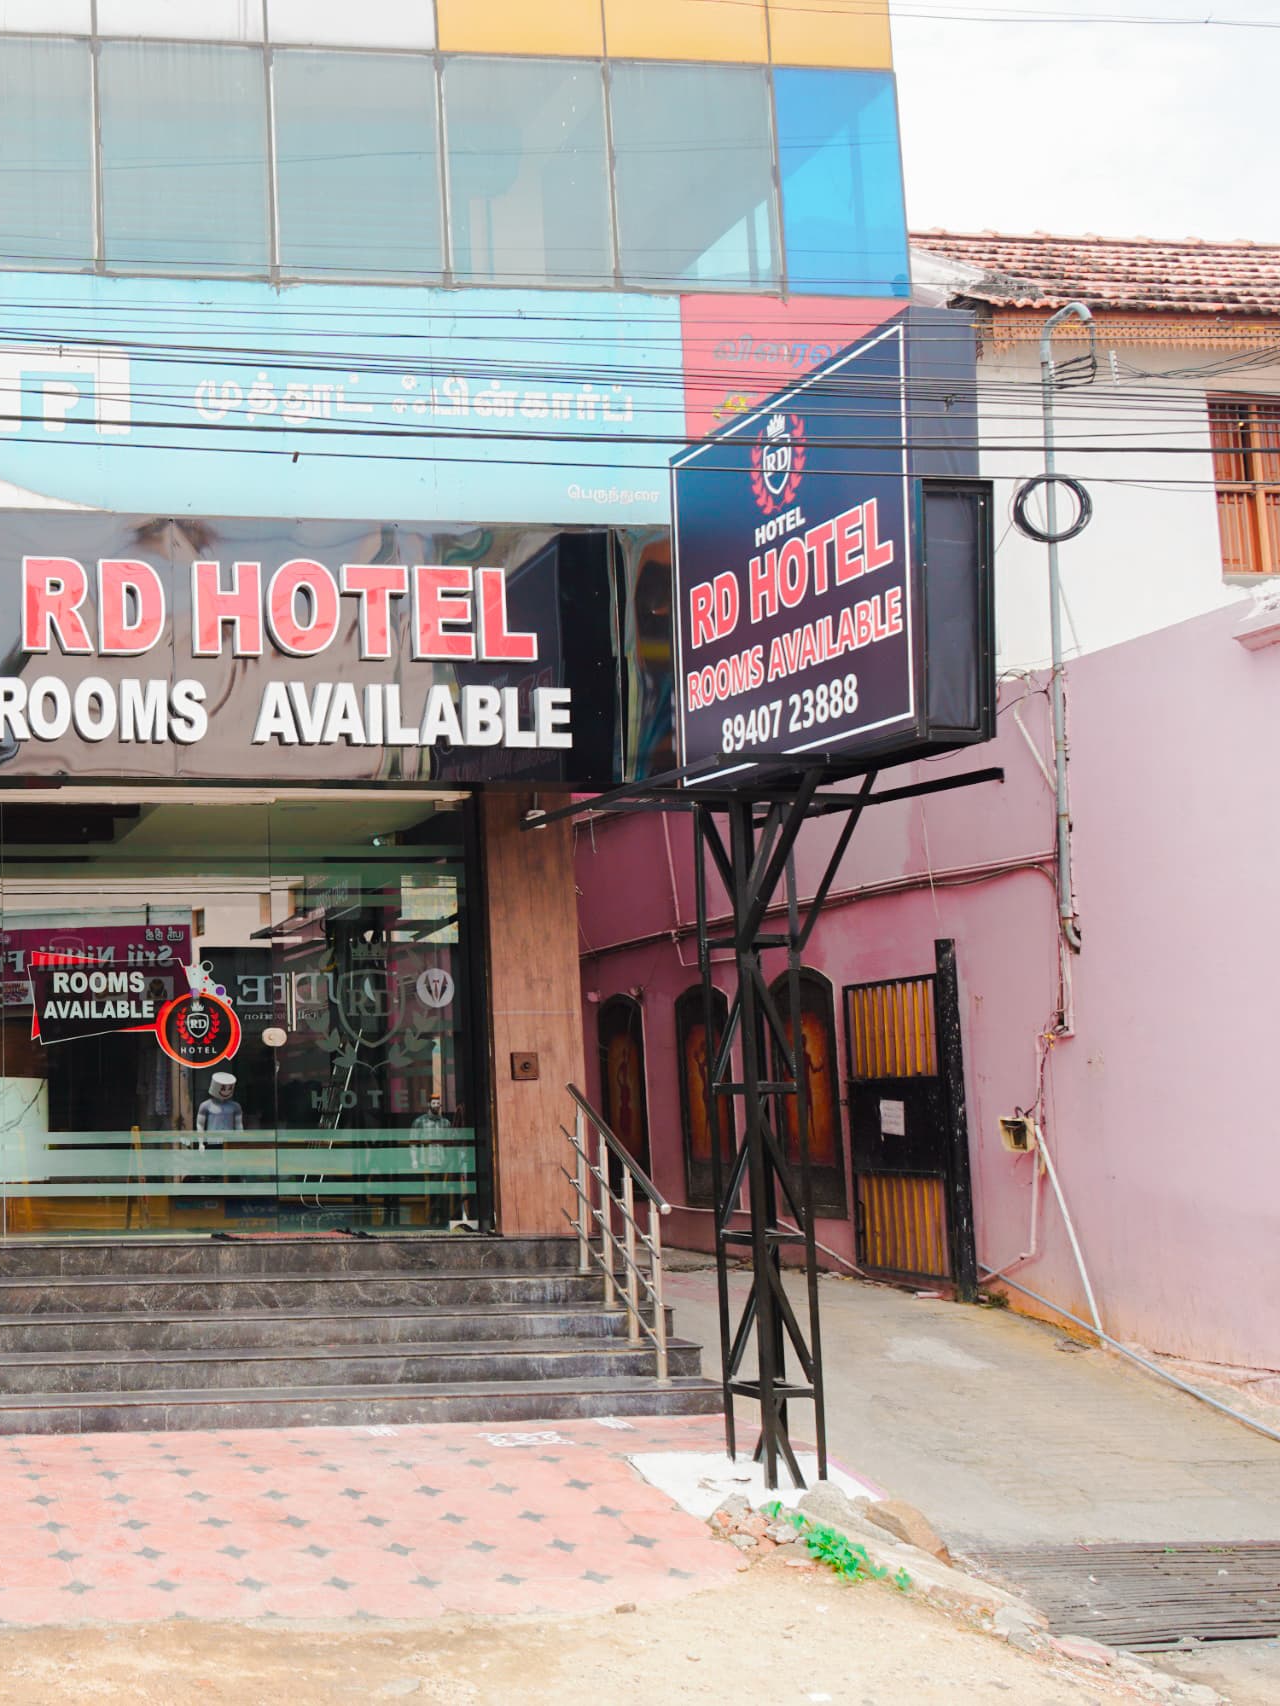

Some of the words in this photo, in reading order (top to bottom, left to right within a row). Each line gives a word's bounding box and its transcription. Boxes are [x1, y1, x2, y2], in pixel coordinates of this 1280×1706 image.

[765, 446, 788, 478] RD
[754, 505, 806, 548] HOTEL
[689, 569, 740, 651] RD
[748, 497, 895, 625] HOTEL
[21, 554, 167, 656] RD
[190, 558, 539, 663] HOTEL
[687, 643, 766, 713] ROOMS
[766, 585, 904, 682] AVAILABLE
[253, 680, 574, 749] AVAILABLE
[721, 700, 783, 755] 89407
[787, 673, 860, 733] 23888
[53, 971, 145, 994] ROOMS
[44, 1000, 155, 1019] AVAILABLE
[190, 1019, 207, 1029] RD
[181, 1046, 217, 1054] HOTEL
